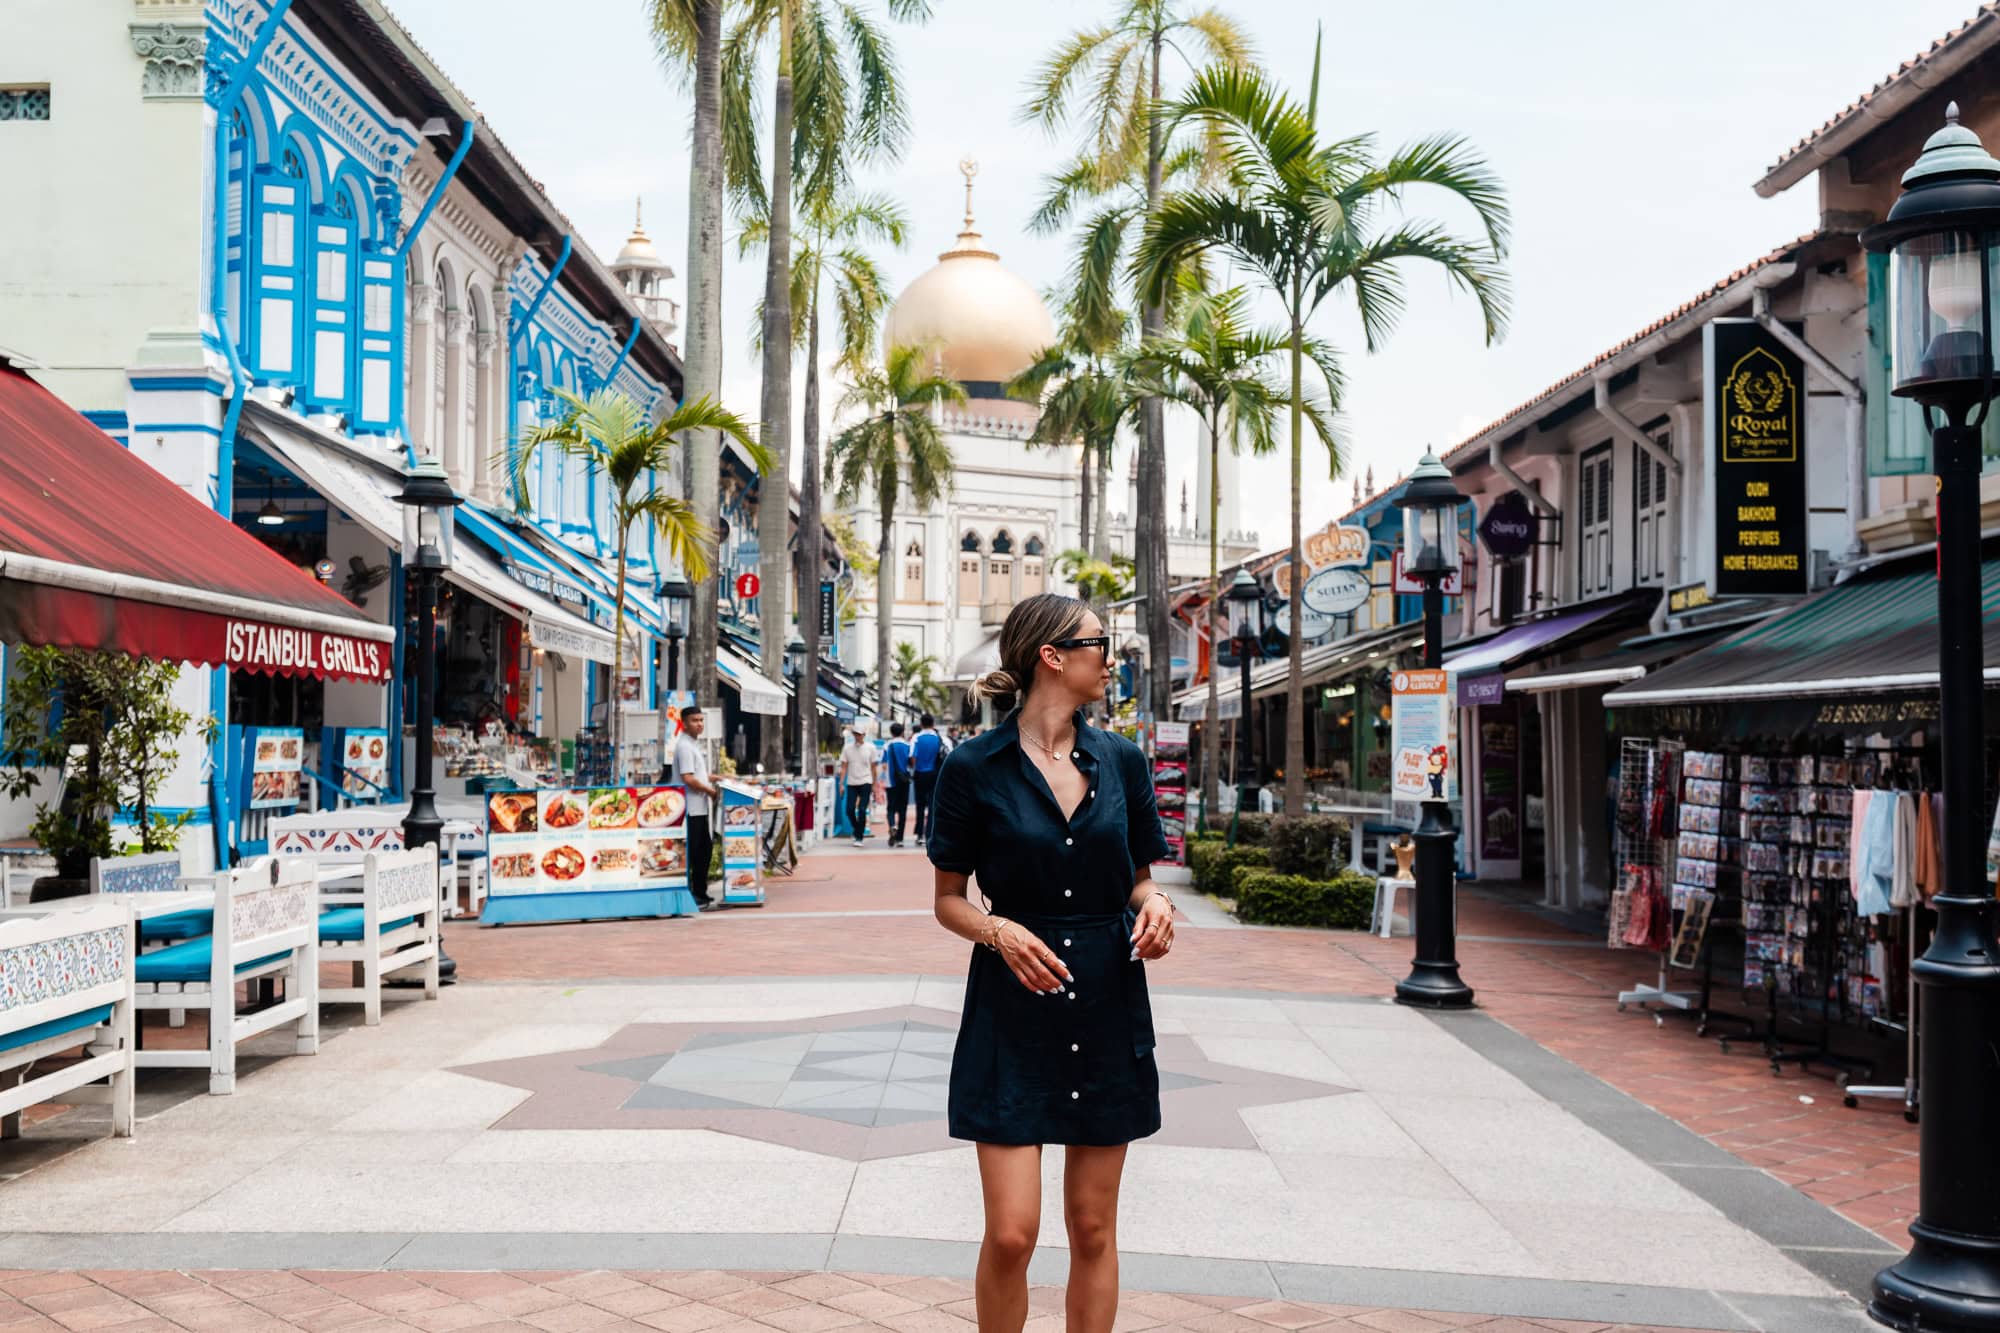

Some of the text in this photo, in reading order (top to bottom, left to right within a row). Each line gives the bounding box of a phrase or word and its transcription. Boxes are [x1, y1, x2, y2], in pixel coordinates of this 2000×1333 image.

[1731, 415, 1787, 437] Royal
[1317, 583, 1357, 598] SULTAN
[225, 621, 380, 677] ISTANBUL GRILL'S
[1832, 704, 1896, 723] BSSORAH
[1897, 701, 1941, 721] STREE
